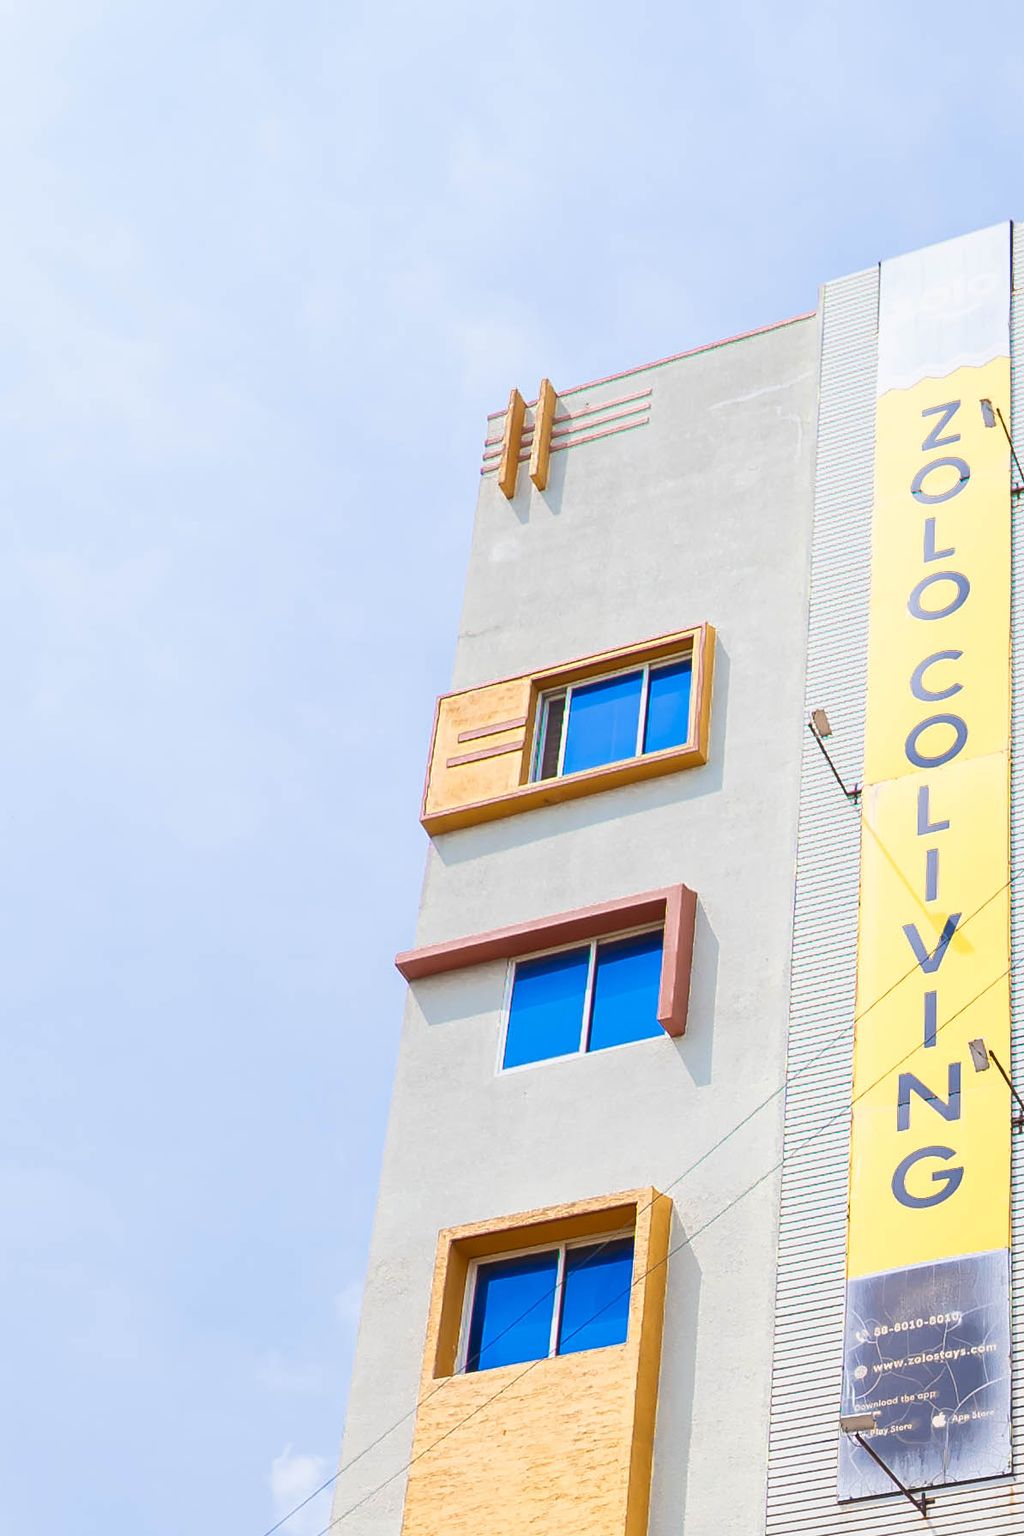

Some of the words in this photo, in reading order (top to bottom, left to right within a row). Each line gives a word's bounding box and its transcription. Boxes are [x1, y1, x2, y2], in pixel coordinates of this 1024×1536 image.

[907, 399, 970, 621] ZOLO
[890, 649, 969, 1210] COLIVING
[872, 1343, 998, 1374] www.zolostays.com
[854, 1396, 898, 1411] Download
[900, 1393, 915, 1403] the
[917, 1390, 937, 1401] app
[890, 1423, 913, 1433] Store
[952, 1413, 970, 1424] App
